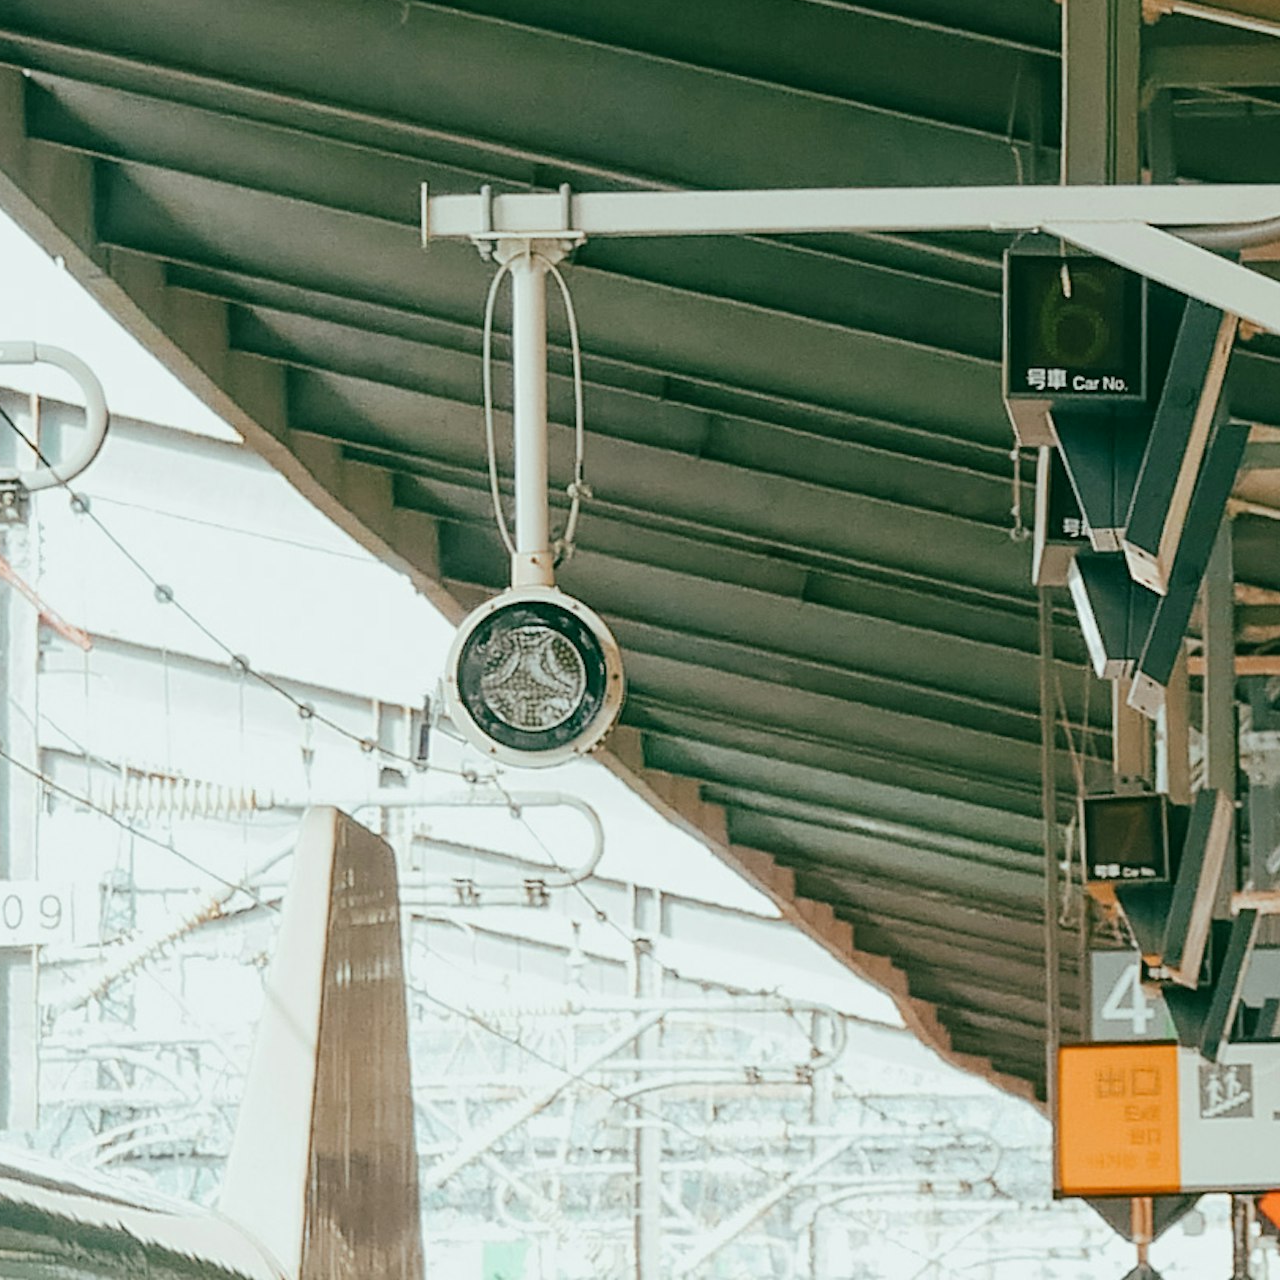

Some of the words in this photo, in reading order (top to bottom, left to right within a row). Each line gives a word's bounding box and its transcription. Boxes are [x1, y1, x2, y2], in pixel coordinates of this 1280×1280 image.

[1026, 368, 1067, 391] 号車
[1072, 376, 1100, 391] Car
[1102, 376, 1129, 392] No.
[1101, 964, 1155, 1035] 4
